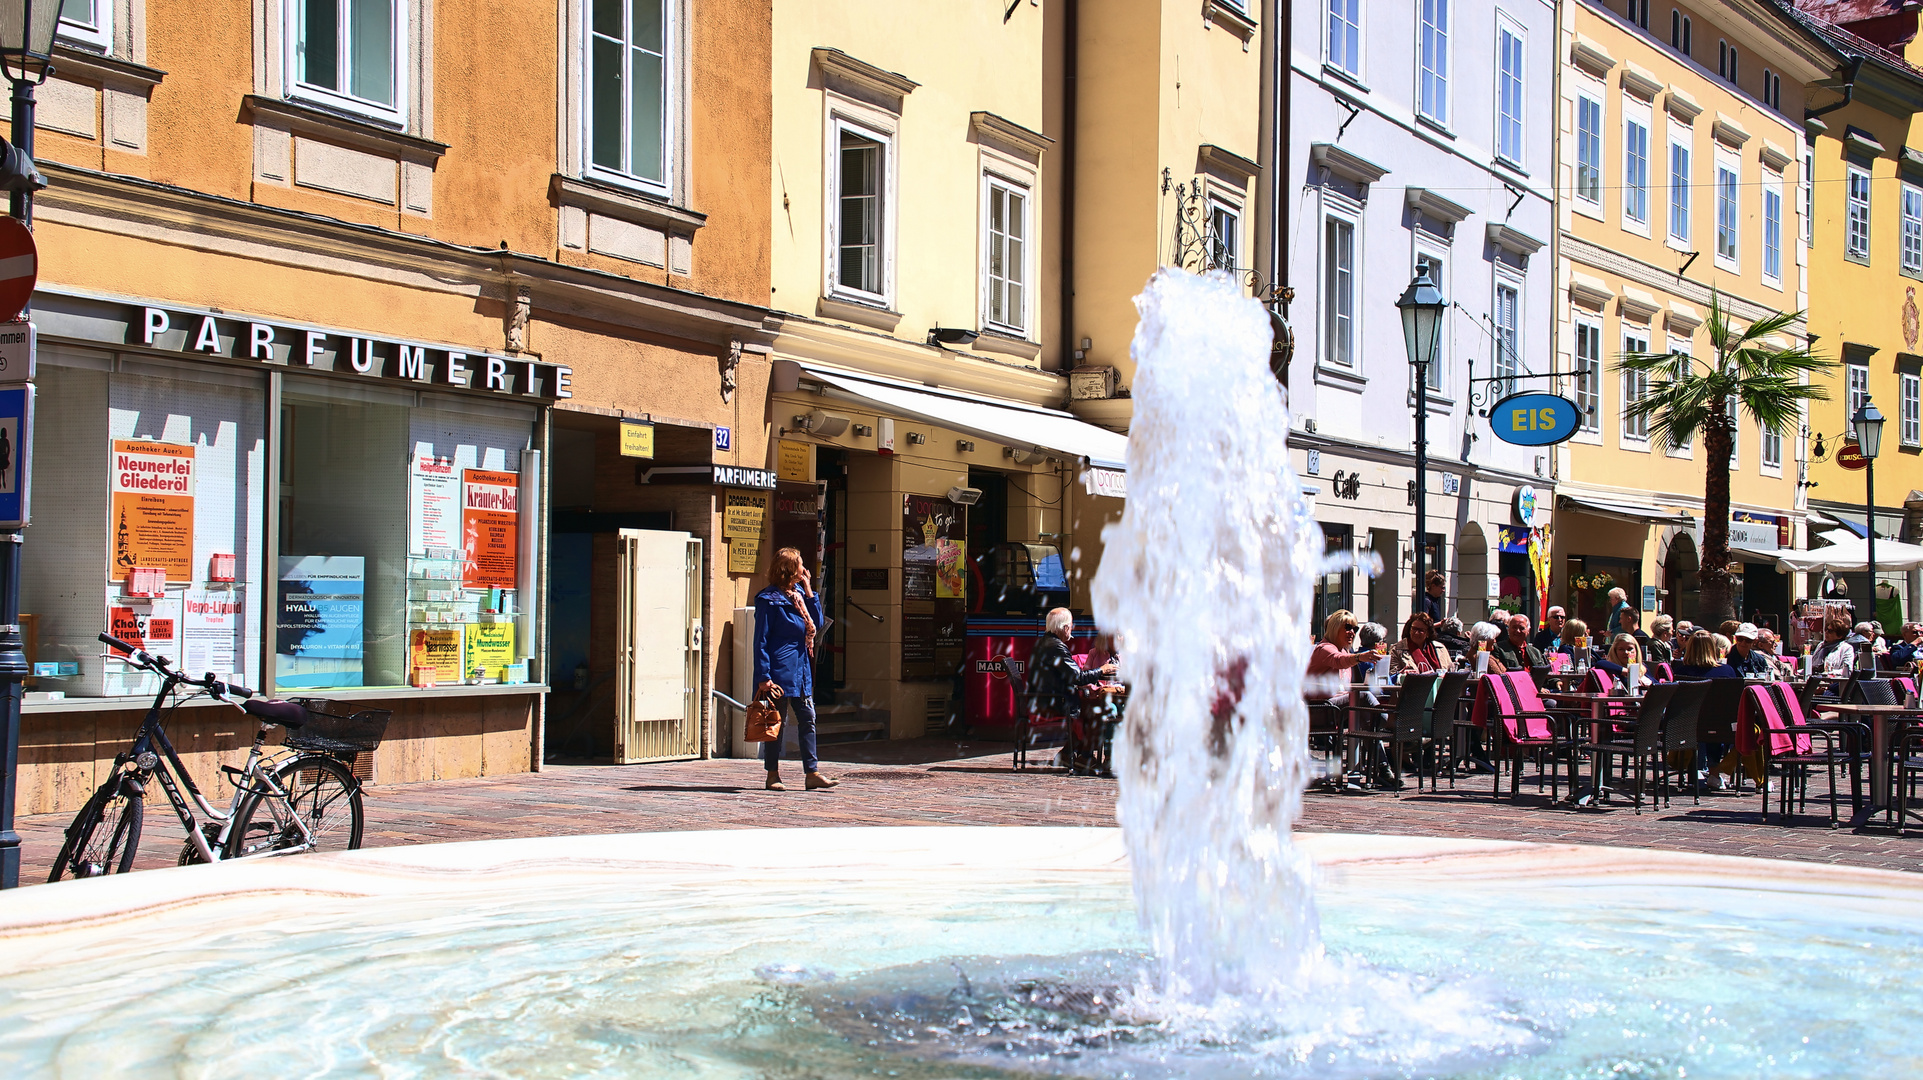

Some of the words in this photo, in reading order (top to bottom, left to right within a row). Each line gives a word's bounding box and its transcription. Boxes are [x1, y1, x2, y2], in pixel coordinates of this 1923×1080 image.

[144, 307, 573, 398] PARFUMERIE
[1512, 408, 1556, 432] EIS
[627, 430, 647, 439] Einfahrt
[716, 429, 728, 446] 32
[126, 444, 160, 453] Apotheker
[624, 443, 649, 452] freihalten!
[1840, 453, 1863, 461] EDUSC
[118, 456, 190, 475] Neunerlei
[120, 472, 188, 491] Gliederöl
[714, 466, 777, 488] PARFUMERIE
[1333, 469, 1360, 500] Café
[467, 484, 518, 511] Kräuter-Bad
[187, 600, 242, 615] Veno-Liquid
[114, 619, 145, 628] Cholo
[114, 630, 146, 639] Liquid
[477, 638, 510, 647] Mundwasser
[978, 662, 1022, 672] MARI
[160, 771, 191, 821] SIGA
